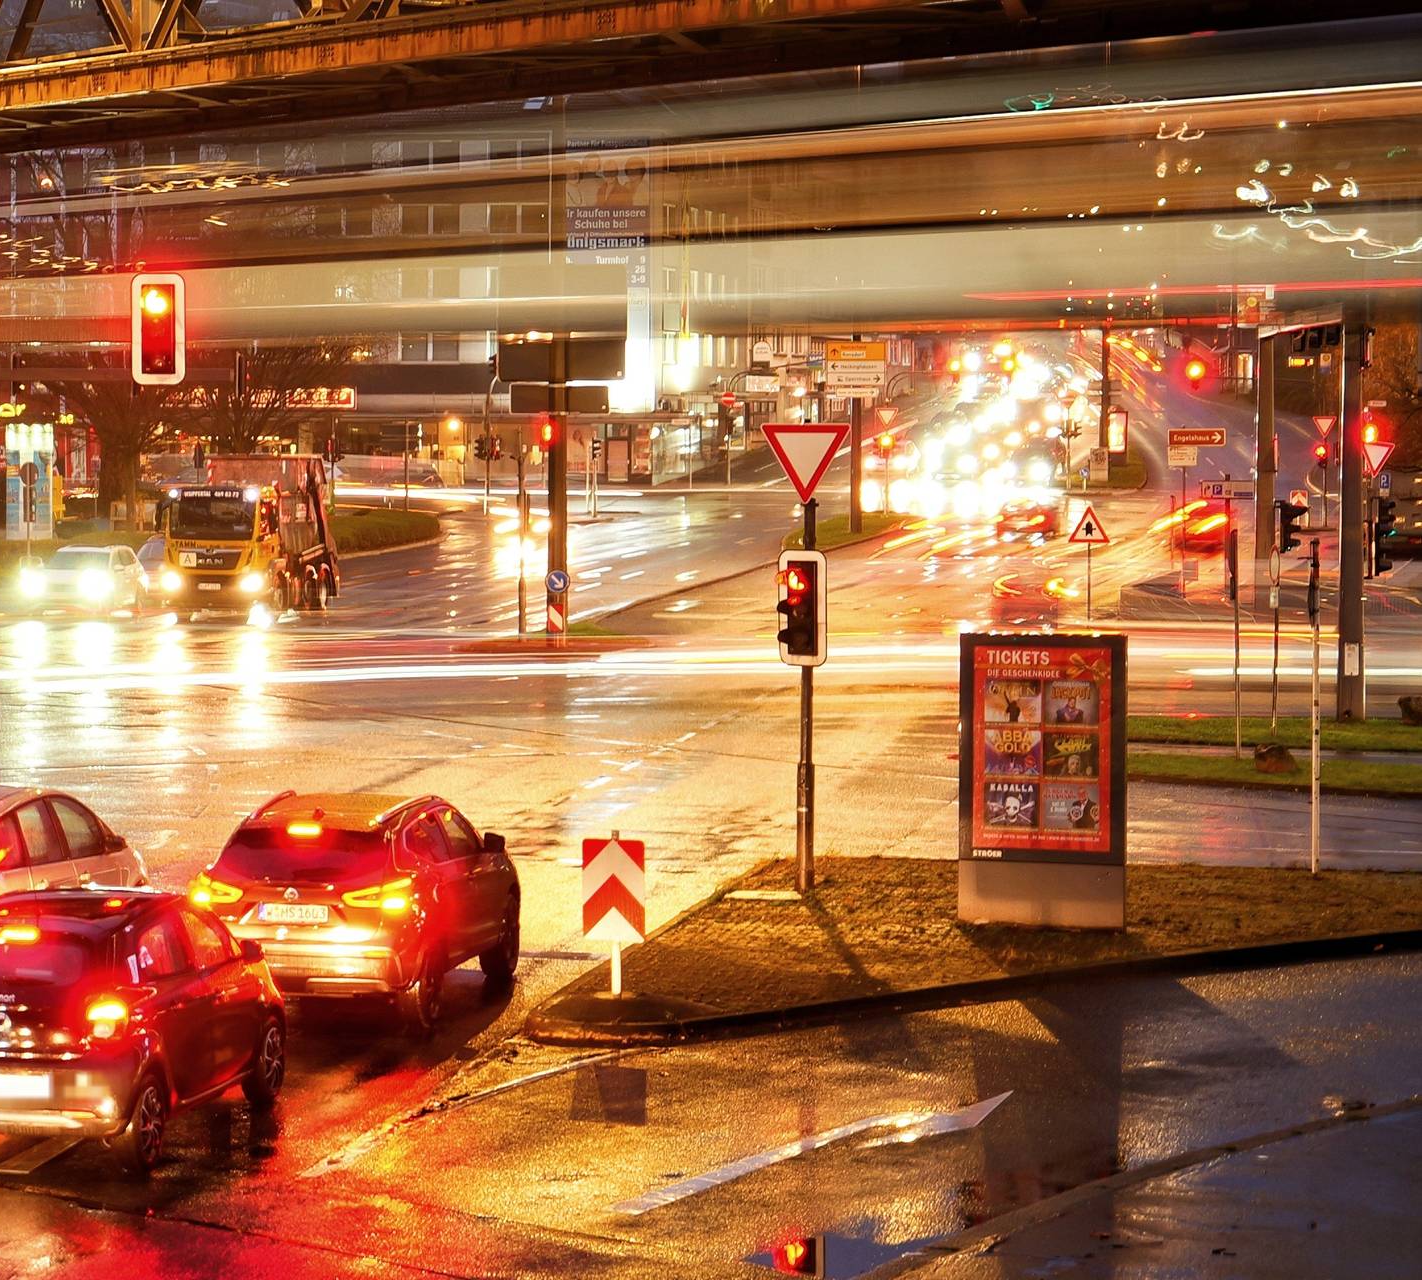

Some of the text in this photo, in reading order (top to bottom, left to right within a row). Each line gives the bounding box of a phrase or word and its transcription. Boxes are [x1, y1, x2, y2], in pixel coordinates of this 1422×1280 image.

[566, 208, 646, 218] ir kaufen unsere
[574, 219, 628, 229] Schuhe bei
[567, 235, 645, 250] önigsmark
[1173, 433, 1210, 442] Engelshaus
[184, 554, 191, 565] A
[986, 649, 1050, 665] TICKETS
[987, 668, 1061, 678] DIE GESCHENKIDEE
[992, 730, 1033, 742] ABBA
[994, 742, 1031, 753] GOLD
